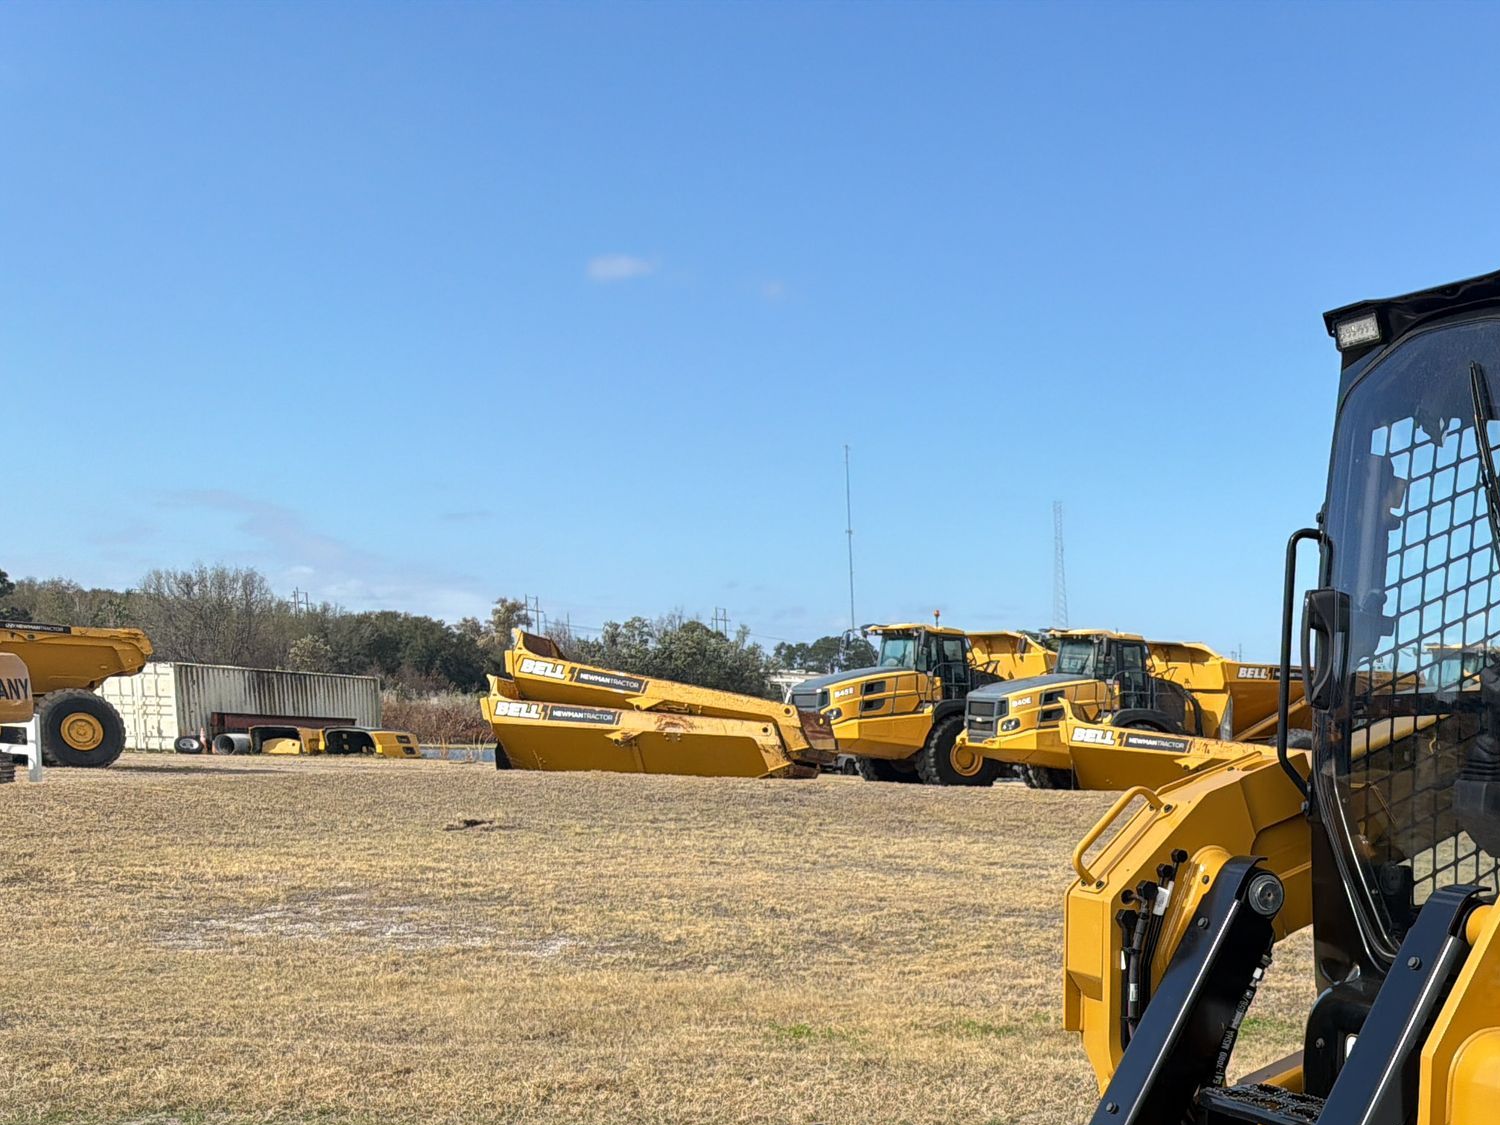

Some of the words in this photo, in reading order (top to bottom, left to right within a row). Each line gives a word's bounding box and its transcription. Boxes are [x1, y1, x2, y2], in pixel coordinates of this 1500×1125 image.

[519, 658, 566, 680] BELL
[1237, 666, 1268, 679] BELL
[494, 700, 541, 719] BELL
[1072, 727, 1115, 745] BELL
